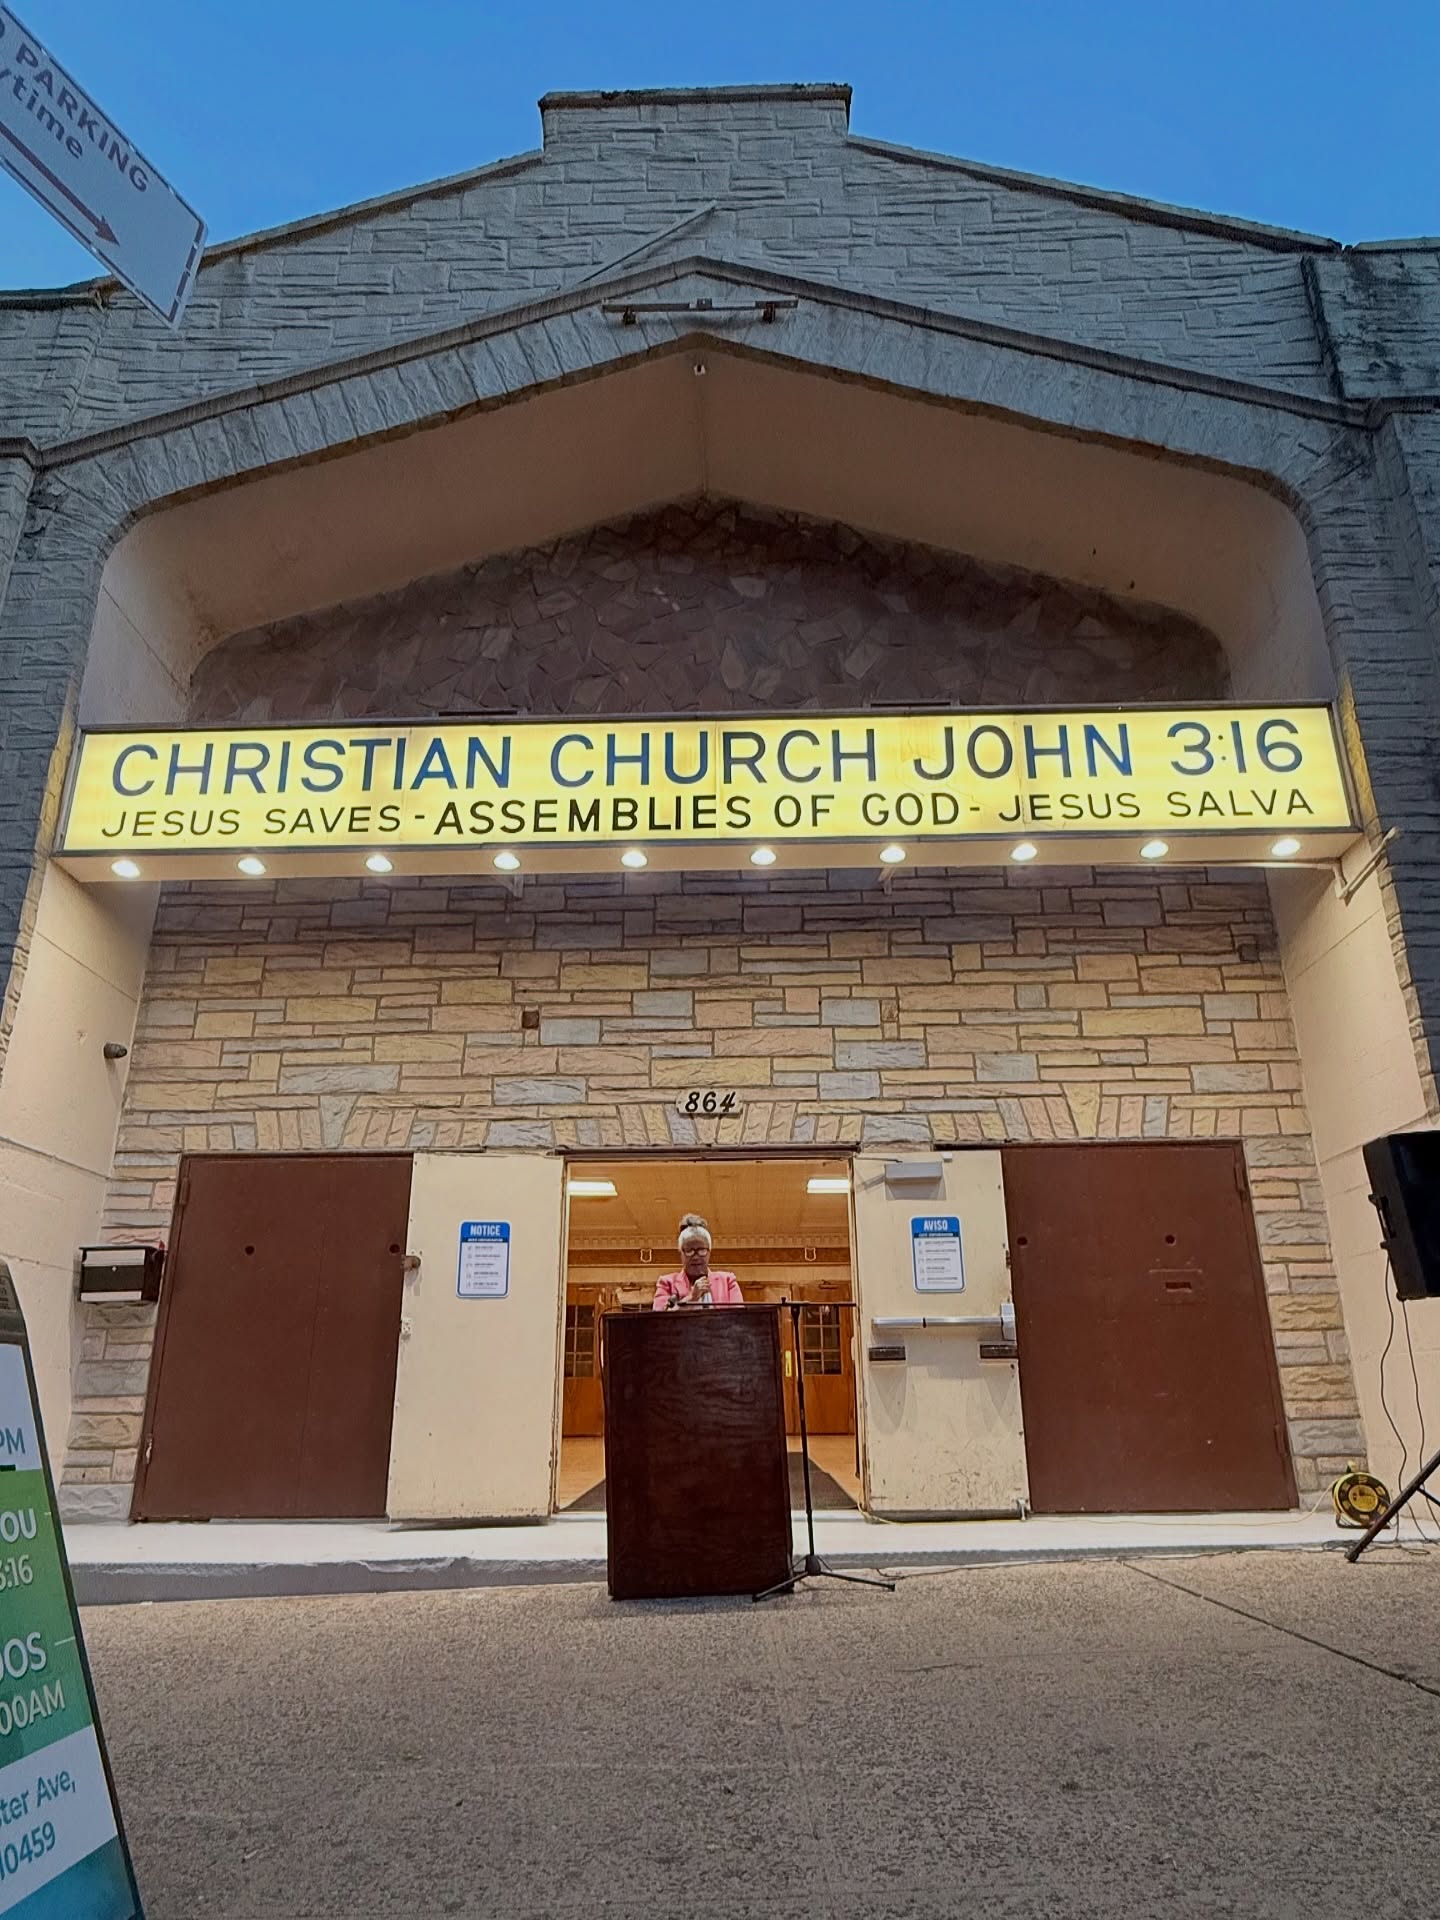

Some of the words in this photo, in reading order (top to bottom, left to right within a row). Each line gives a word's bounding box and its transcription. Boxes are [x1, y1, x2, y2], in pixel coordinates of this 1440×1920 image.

[16, 43, 149, 193] PARKING
[112, 736, 511, 796] CHRISTIAN
[550, 728, 877, 787] CHURCH
[913, 723, 1133, 781] JOHN
[1167, 719, 1303, 775] 3:16
[101, 809, 240, 837] JESUS
[774, 795, 835, 828] OF
[1167, 789, 1314, 817] SALVA
[685, 1091, 736, 1112] 864
[470, 1224, 501, 1236] NOTICE
[924, 1219, 948, 1231] AVISO
[0, 1632, 47, 1680] OS
[0, 1789, 29, 1827] ter
[37, 1770, 76, 1808] Ave,
